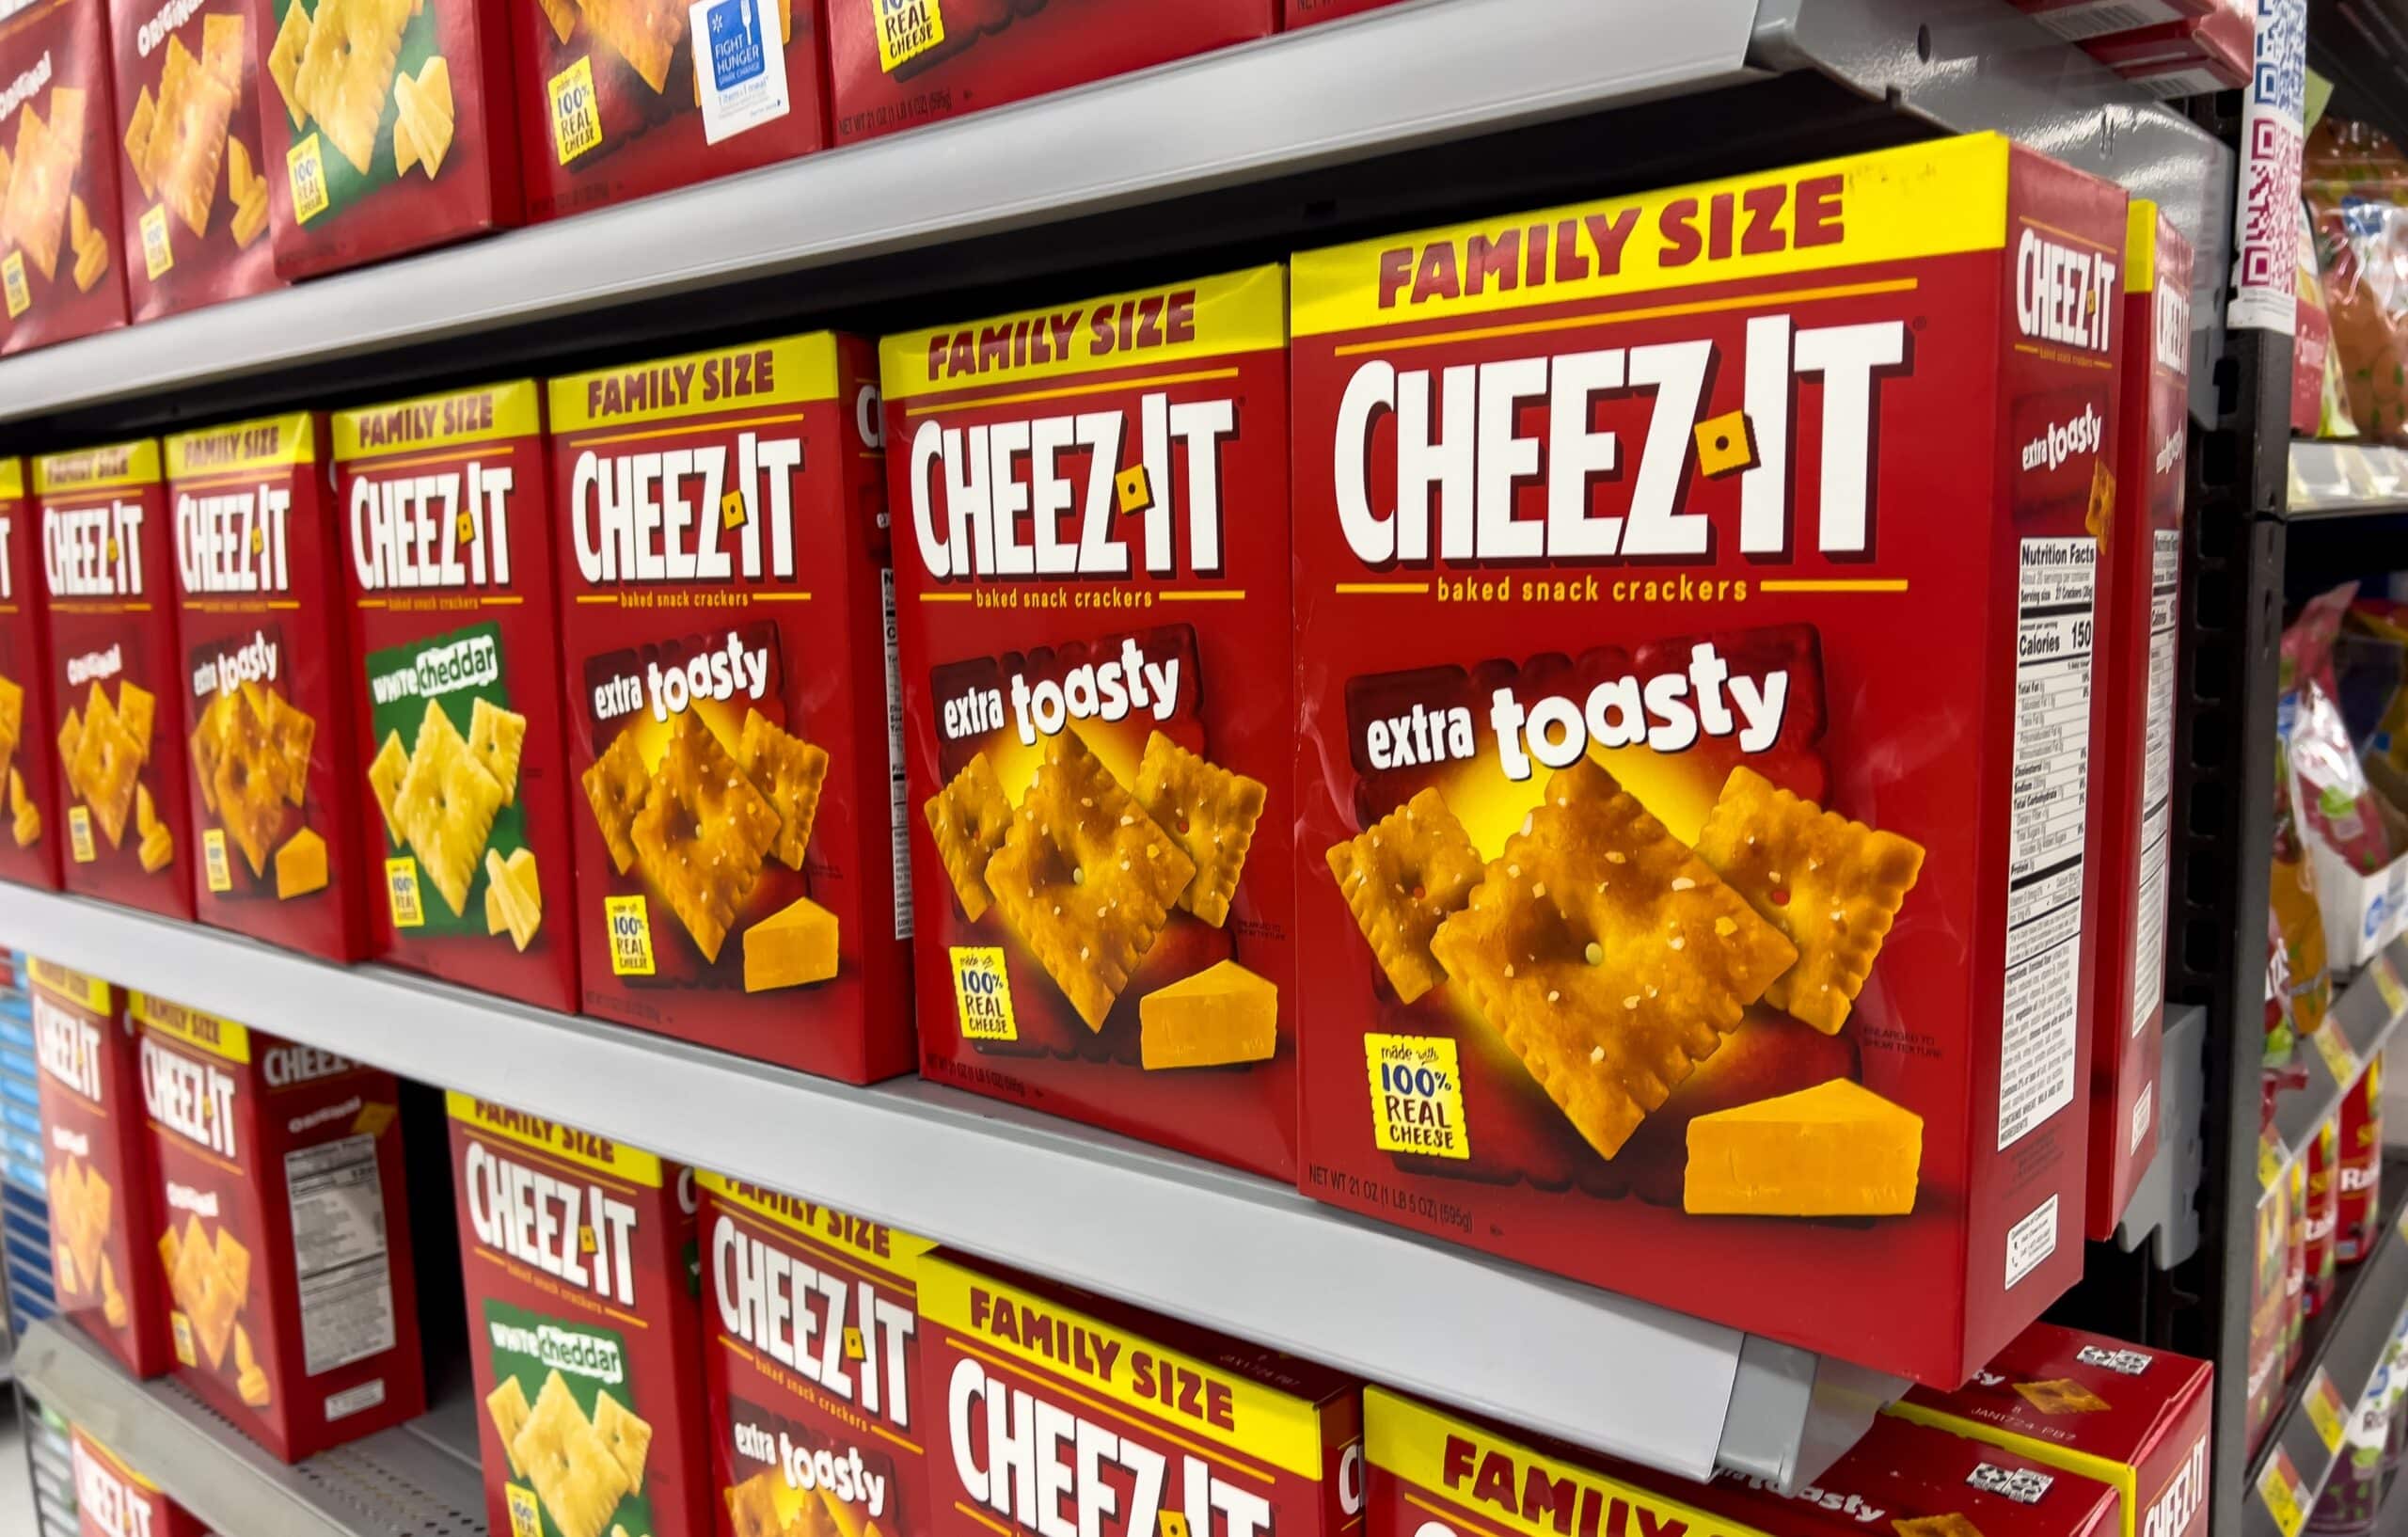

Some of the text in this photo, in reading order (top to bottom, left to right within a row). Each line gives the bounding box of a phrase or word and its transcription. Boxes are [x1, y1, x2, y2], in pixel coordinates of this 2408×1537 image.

[885, 5, 930, 42] REAL
[890, 24, 933, 60] CHEESE
[715, 34, 743, 60] FIGHT
[561, 108, 593, 139] REAL
[1378, 174, 1845, 309] FAMILY SIZE
[928, 289, 1196, 381] FAMILY SIZE
[588, 350, 774, 420] FAMILY SIZE
[358, 393, 494, 450] FAMILY SIZE
[2022, 437, 2048, 470] extra
[2048, 402, 2101, 470] toasty
[2022, 542, 2094, 565] Nutrition Facts
[694, 589, 749, 607] crackers
[976, 586, 1151, 608] baked snack crackers
[1438, 573, 1748, 601] baked snack crackers
[2020, 620, 2092, 657] Calories 150
[417, 640, 496, 691] cheddar
[594, 631, 768, 722] extra toasty
[943, 638, 1179, 745] extra toasty
[1367, 642, 1787, 780] extra toasty
[961, 970, 1004, 994] 100%
[965, 994, 1005, 1018] REAL
[1381, 1044, 1413, 1061] made
[1381, 1062, 1452, 1098] 100%
[1385, 1095, 1452, 1128] REAL
[562, 1124, 614, 1164] SIZE
[1390, 1125, 1454, 1149] CHEESE
[1308, 1163, 1328, 1185] NET
[1331, 1170, 1346, 1190] WT
[1349, 1175, 1360, 1195] 21
[1364, 1180, 1378, 1200] OZ
[1393, 1189, 1406, 1210] LB
[828, 1208, 890, 1259] SIZE
[971, 1287, 1235, 1433] FAMILY SIZE
[735, 1422, 885, 1516] extra toasty
